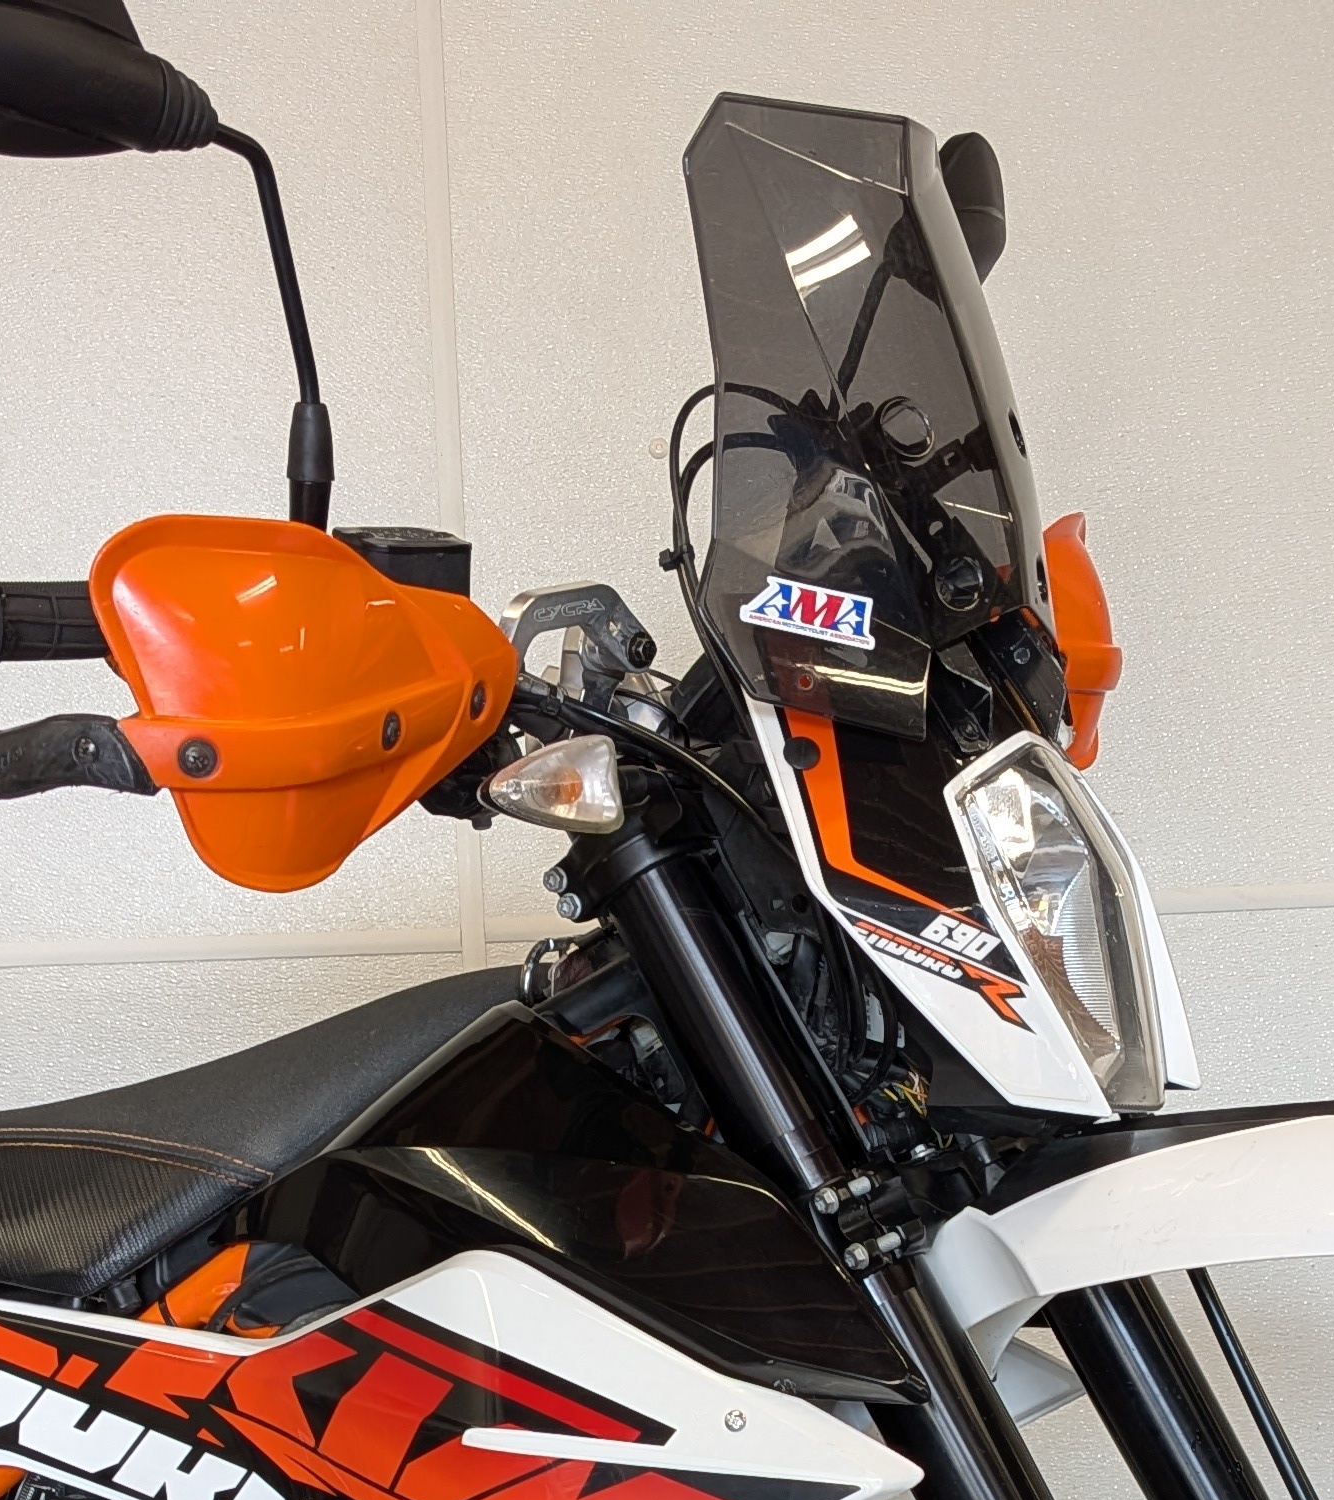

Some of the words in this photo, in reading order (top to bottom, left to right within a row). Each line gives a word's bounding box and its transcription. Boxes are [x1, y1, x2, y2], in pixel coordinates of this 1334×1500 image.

[533, 597, 605, 622] CYCRA
[750, 583, 868, 638] AMA
[920, 914, 1001, 961] 690
